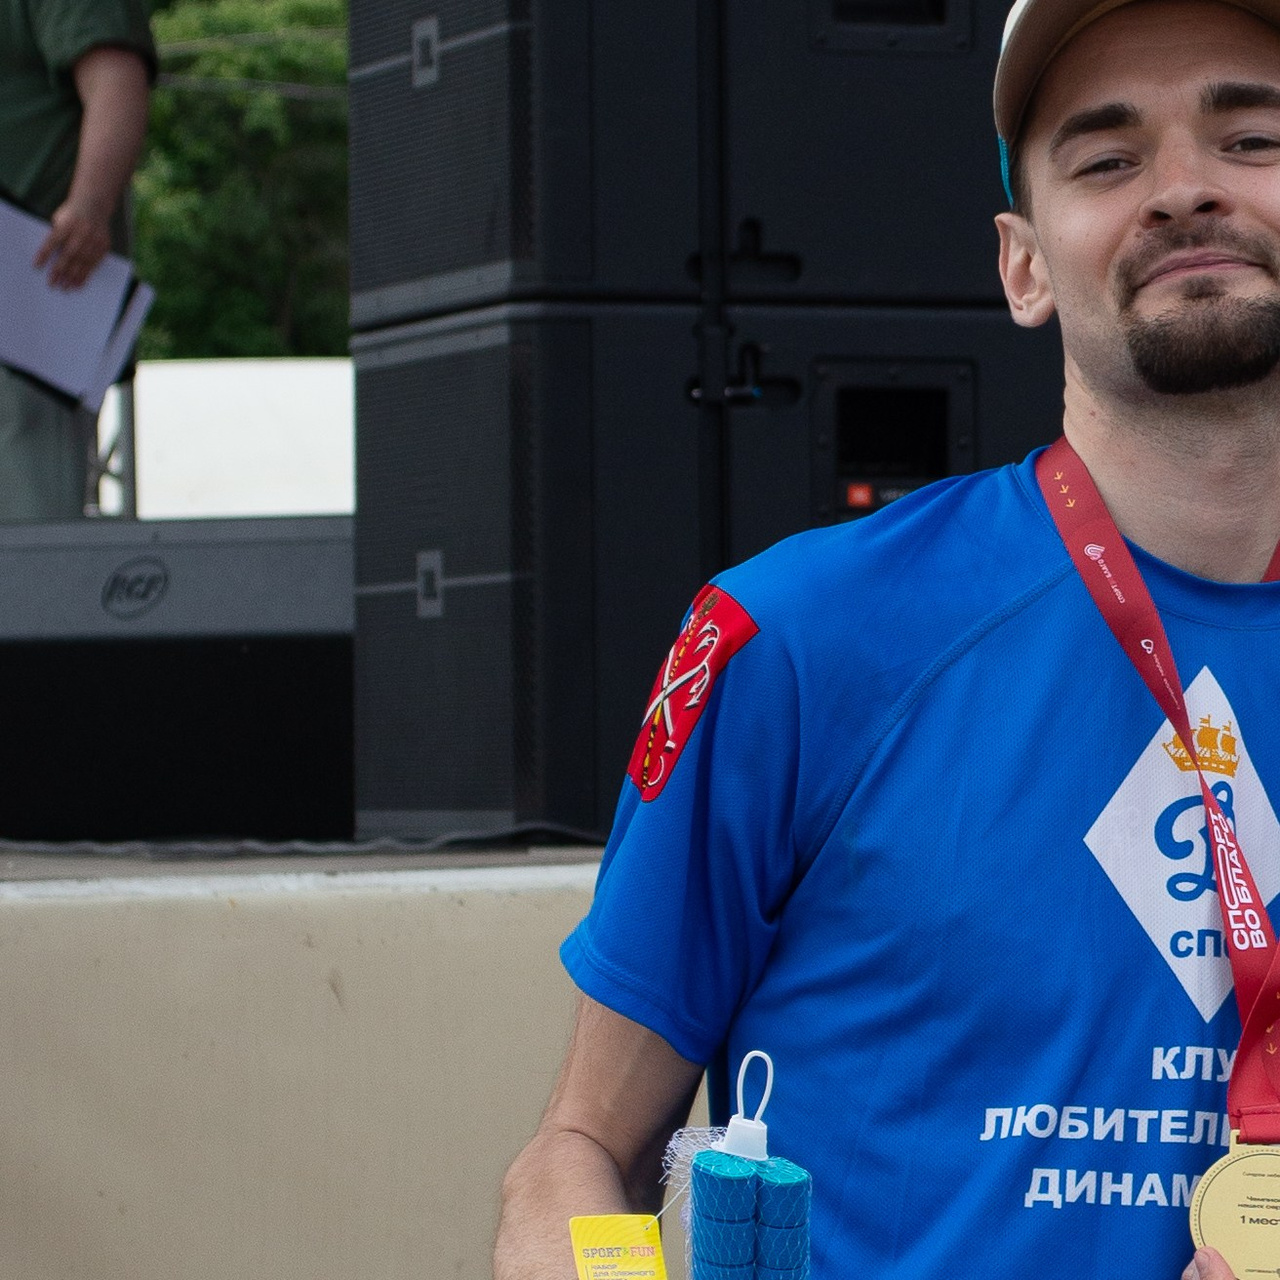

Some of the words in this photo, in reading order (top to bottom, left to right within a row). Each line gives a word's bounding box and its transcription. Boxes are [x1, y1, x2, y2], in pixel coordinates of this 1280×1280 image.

[1208, 808, 1250, 951] СПОРТ
[1169, 929, 1230, 958] СП
[1245, 907, 1268, 950] ВО
[1151, 1046, 1239, 1082] КЛУ
[980, 1104, 1229, 1147] ЛЮБИТЕЛ
[1024, 1168, 1203, 1210] ДИНАМ
[1240, 1215, 1246, 1224] 1
